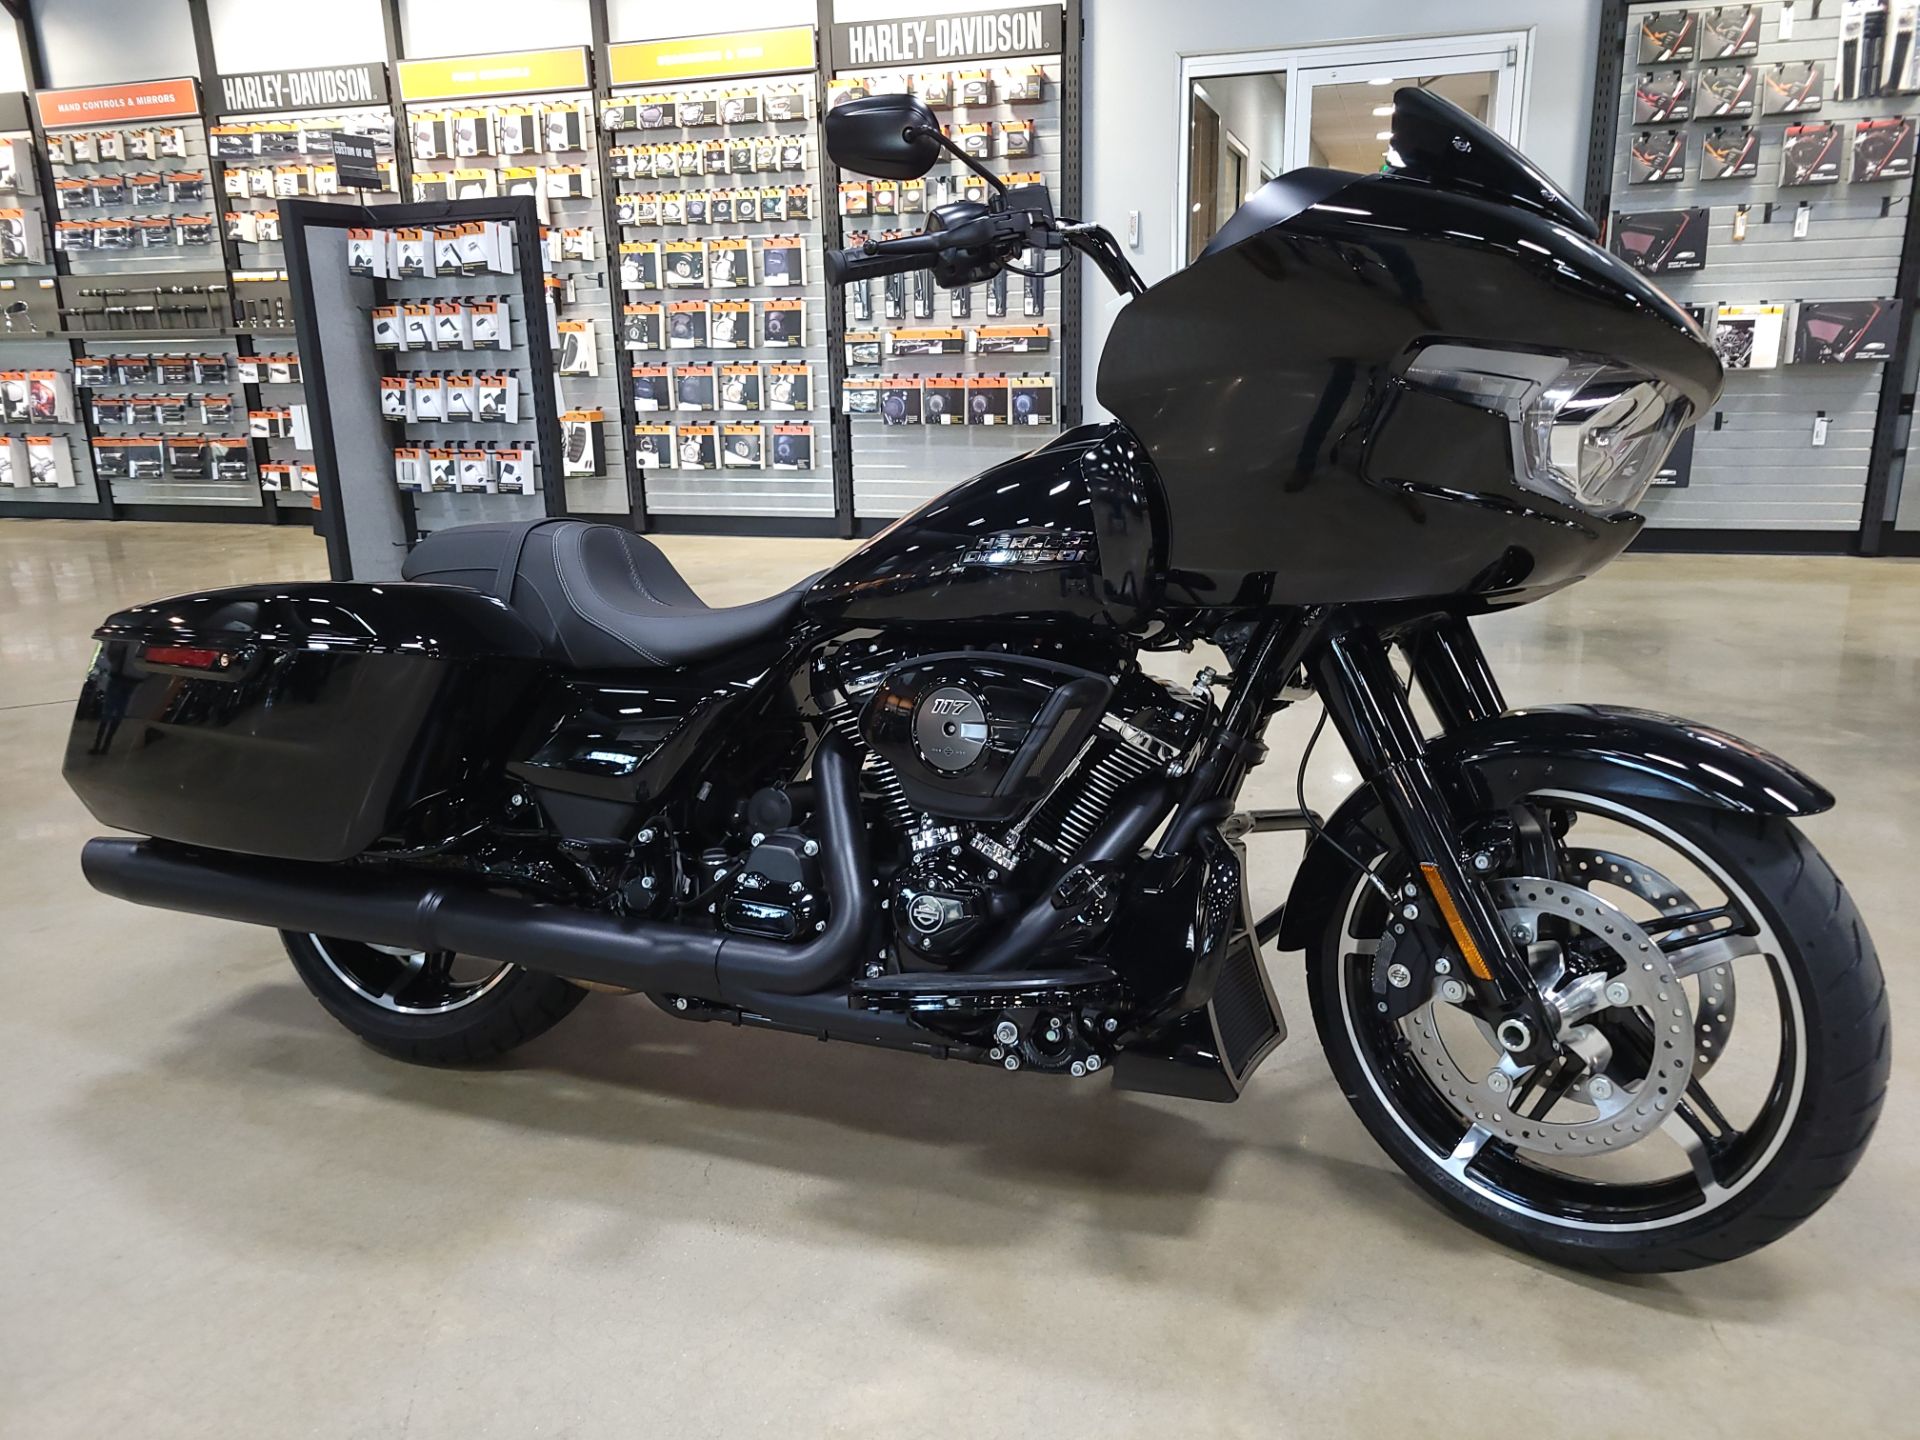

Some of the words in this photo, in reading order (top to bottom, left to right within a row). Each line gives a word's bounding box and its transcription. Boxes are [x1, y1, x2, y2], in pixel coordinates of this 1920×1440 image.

[849, 11, 1043, 64] HARLEY-DAVIDSON
[58, 103, 81, 112] HAND
[82, 98, 126, 111] CONTROLS
[127, 97, 135, 106] &
[135, 94, 176, 105] MIRRORS
[222, 67, 372, 111] HARLEY-DAVIDSON
[931, 698, 972, 715] 117
